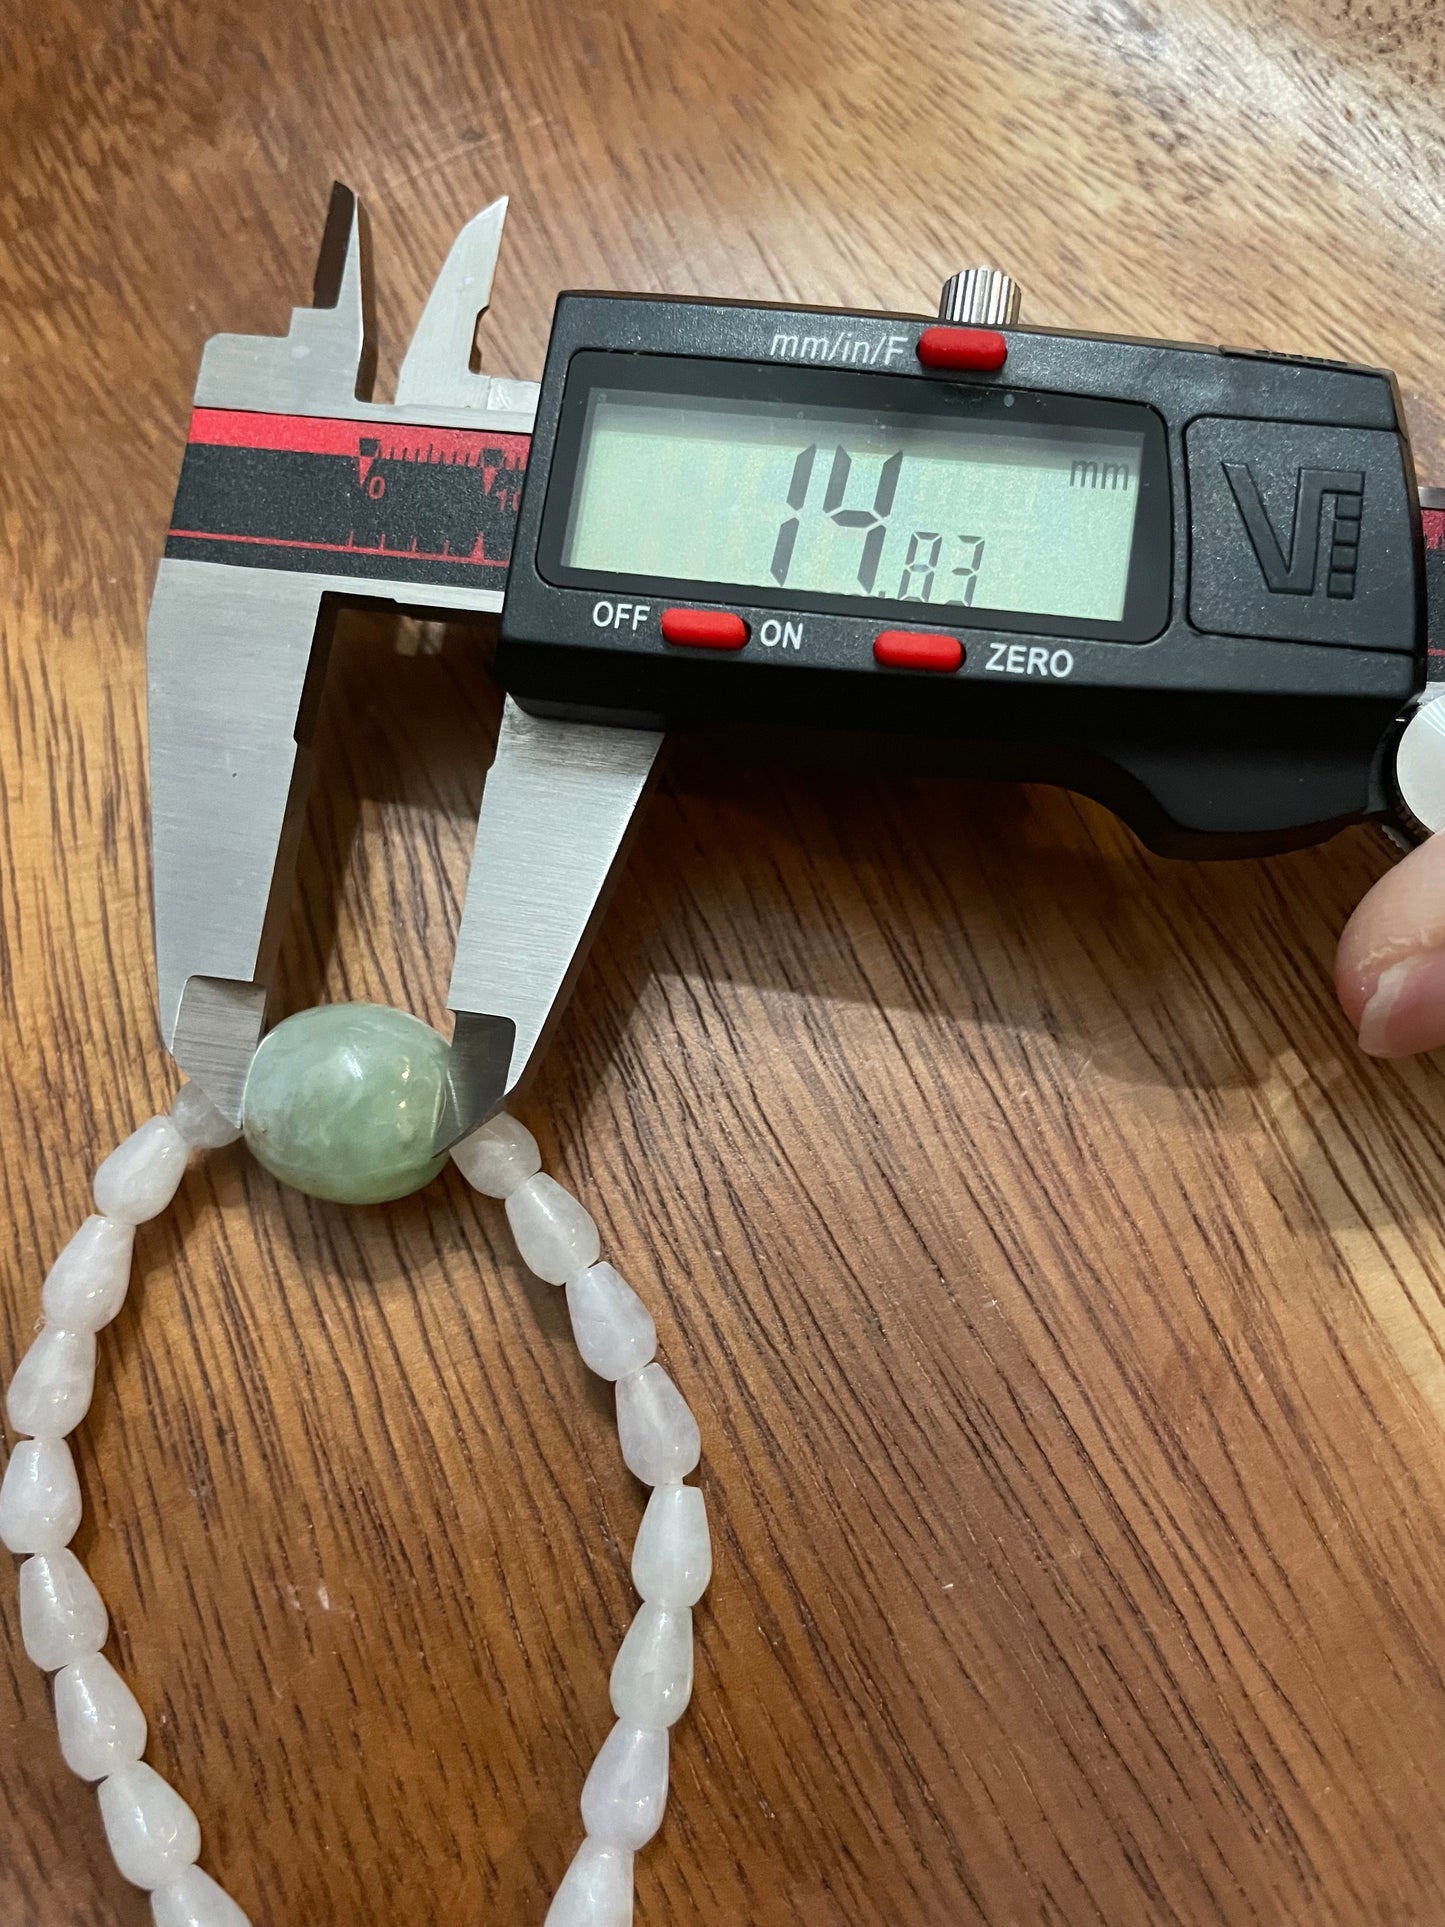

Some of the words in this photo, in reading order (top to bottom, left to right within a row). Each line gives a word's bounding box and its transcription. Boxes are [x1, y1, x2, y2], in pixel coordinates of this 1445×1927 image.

[770, 332, 909, 365] mm/in/F
[368, 476, 386, 500] 0
[1069, 459, 1130, 491] mm
[592, 601, 651, 631] OFF
[759, 618, 804, 650] ON
[985, 642, 1075, 679] ZERO
